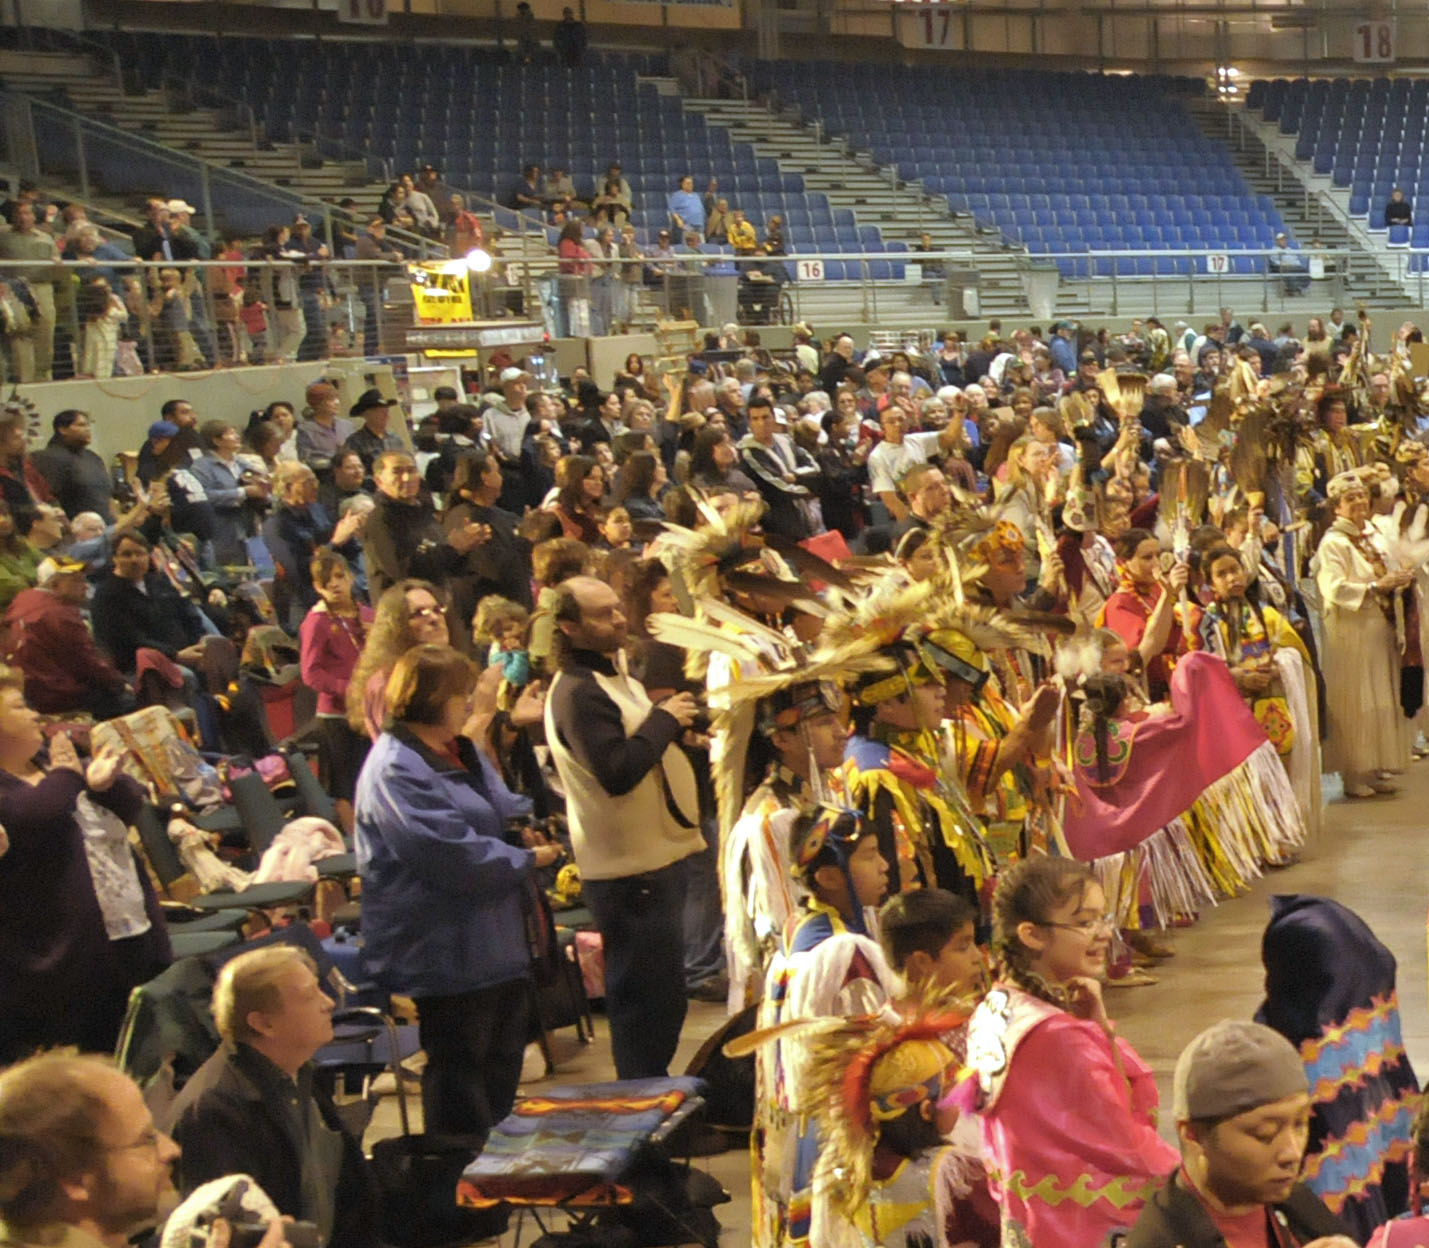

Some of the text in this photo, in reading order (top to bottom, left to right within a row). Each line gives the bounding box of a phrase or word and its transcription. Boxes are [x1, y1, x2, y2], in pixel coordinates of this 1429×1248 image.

[919, 8, 950, 45] 17
[1358, 25, 1392, 58] 18
[803, 262, 820, 279] 16
[1211, 256, 1225, 271] 17
